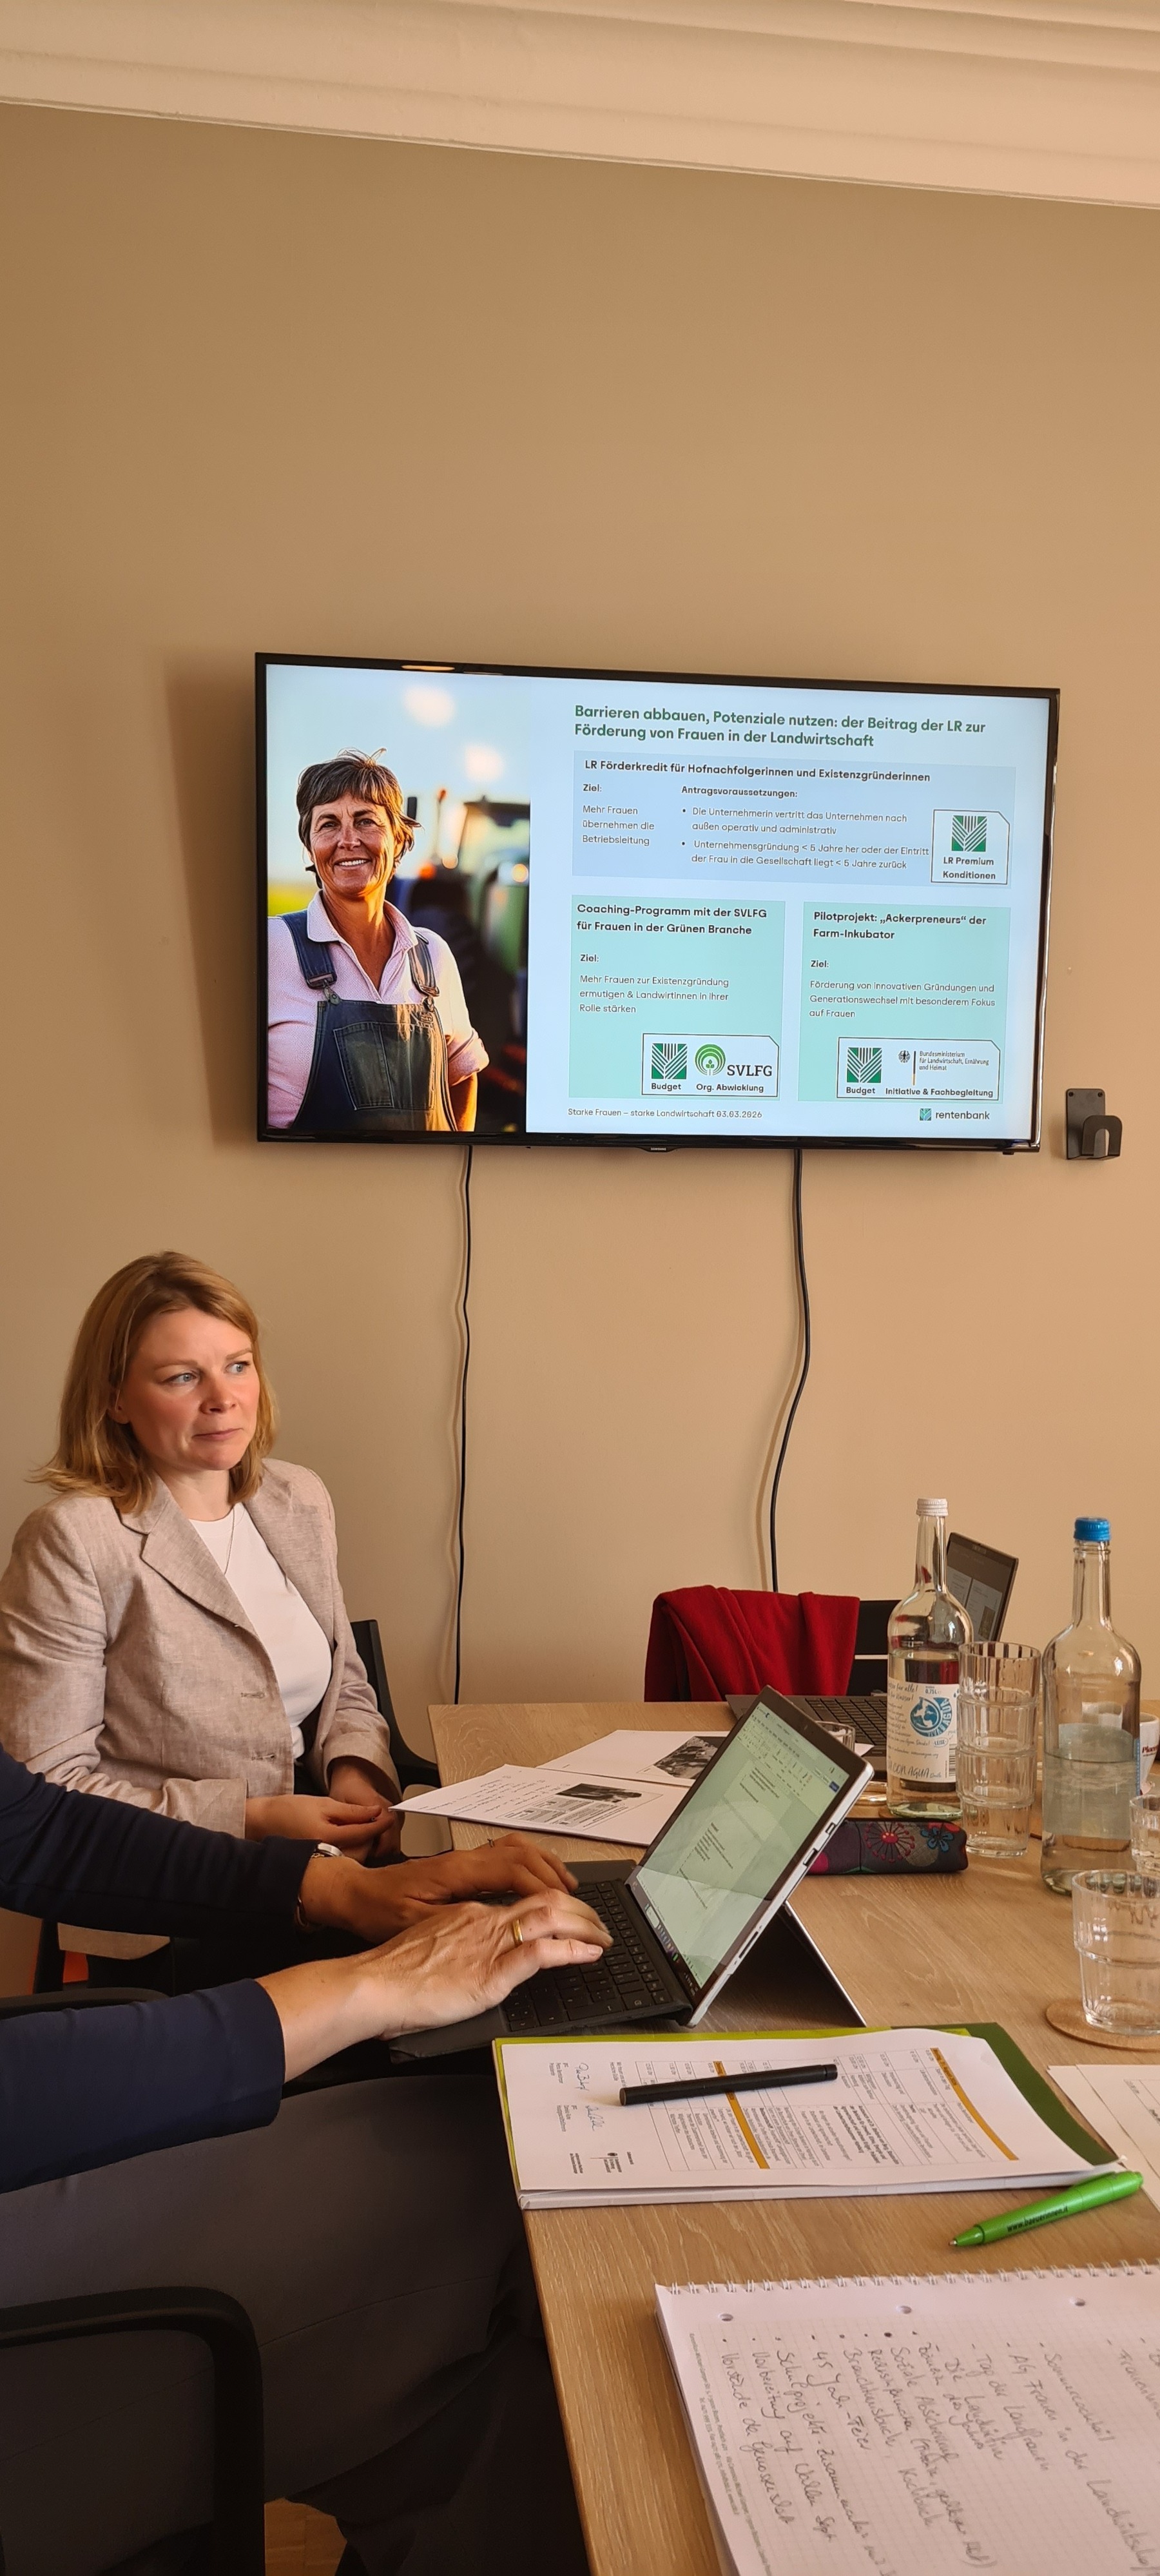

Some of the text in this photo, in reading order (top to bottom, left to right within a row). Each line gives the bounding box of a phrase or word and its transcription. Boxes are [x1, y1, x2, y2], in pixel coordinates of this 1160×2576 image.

[575, 705, 986, 733] Barrieren abbauen, Potenziale nutzen: der Beitrag der LR zur
[575, 723, 874, 746] Förderung von Frauen in der Landwirtschaft
[585, 760, 930, 781] LR Förderkredit für Hofnachfolgerinnen und Existenzgründerinnen
[583, 783, 601, 792] Ziel:
[681, 786, 797, 799] Antragsvoraussetzungen:
[583, 805, 638, 815] Mehr Frauen
[692, 807, 907, 822] Die Unternehmerin vertritt das Unternehmen nach
[582, 819, 655, 830] übernehmen die
[691, 821, 836, 834] außen operativ und administrativ
[582, 834, 650, 846] Betriebsleitung
[694, 840, 799, 850] Unternehmensgründung
[818, 844, 843, 853] Jahre
[845, 844, 860, 853] her
[861, 845, 882, 854] oder
[884, 846, 899, 854] der
[900, 846, 929, 855] Eintritt
[691, 854, 707, 863] der
[709, 855, 728, 863] Frau
[730, 855, 738, 864] in
[740, 855, 754, 864] die
[755, 856, 812, 866] Gesellschaft
[814, 857, 834, 868] liegt
[844, 859, 849, 867] 5
[851, 859, 876, 868] Jahre
[878, 860, 907, 869] zurück
[956, 857, 994, 865] Premium
[943, 870, 996, 879] Konditionen
[577, 904, 767, 918] Coaching-Programm mit der SVLFG
[814, 911, 987, 925] Pilotprojekt: „Ackerpreneurs“ der
[576, 921, 751, 934] für Frauen in der Grünen Branche
[813, 928, 894, 939] Farm-Inkubator
[580, 953, 599, 962] Ziel:
[580, 975, 603, 983] Mehr
[604, 975, 635, 984] Frauen
[652, 976, 729, 988] Existenzgründung
[810, 980, 855, 991] Förderung
[874, 982, 922, 990] innovativen
[923, 983, 976, 993] Gründungen
[978, 984, 994, 992] und
[579, 990, 624, 1000] ermutigen
[626, 990, 633, 999] &
[636, 990, 697, 1000] Landwirtinnen
[709, 991, 729, 1000] ihrer
[809, 995, 898, 1004] Generationswechsel
[915, 997, 969, 1006] besonderem
[971, 998, 995, 1006] Fokus
[579, 1004, 636, 1013] Rolle stärken
[826, 1009, 855, 1017] Frauen
[727, 1064, 772, 1077] SVLFG
[651, 1082, 681, 1091] Budget
[696, 1083, 764, 1093] Org. Abwicklung
[846, 1086, 875, 1095] Budget
[931, 1088, 993, 1098] Fachbegleitung
[935, 1110, 990, 1120] rentenbank
[813, 2352, 833, 2367] 45
